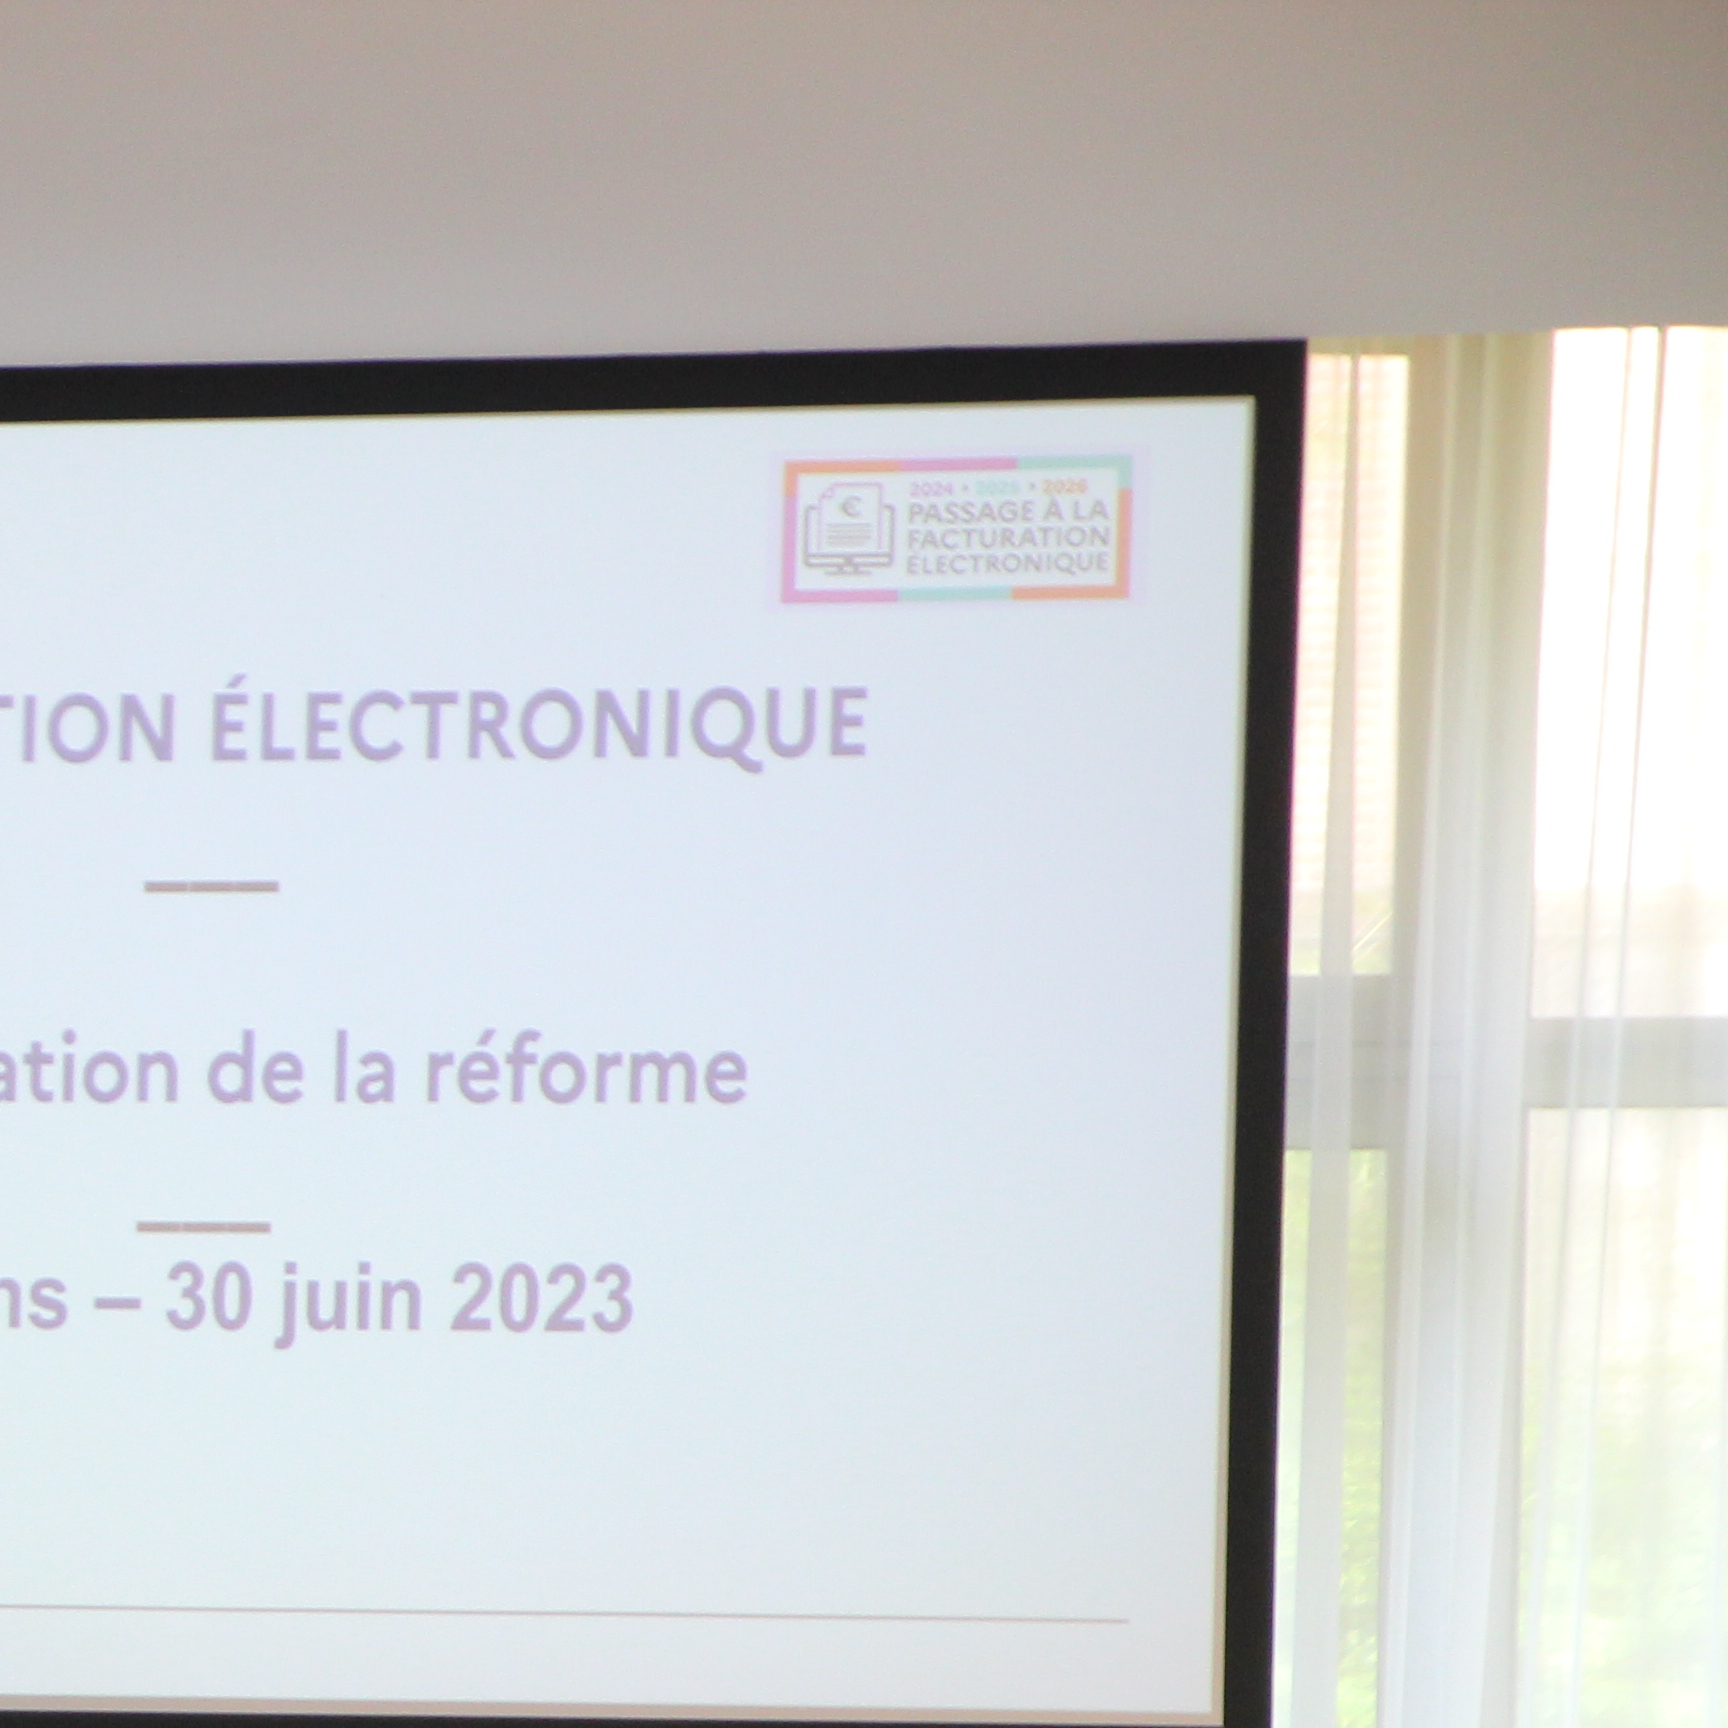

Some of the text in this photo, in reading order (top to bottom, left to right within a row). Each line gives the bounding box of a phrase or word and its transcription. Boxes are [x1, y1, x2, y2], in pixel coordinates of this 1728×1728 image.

[908, 501, 1035, 524] PASSAGE
[1073, 500, 1110, 521] LA
[908, 525, 1110, 549] FACTURATION
[211, 674, 869, 775] ÉLECTRONIQUE
[206, 1028, 305, 1105] de
[333, 1029, 396, 1105] la
[426, 1028, 748, 1105] réforme
[164, 1260, 254, 1332] 30
[273, 1260, 422, 1350] juin
[450, 1261, 634, 1334] 2023
